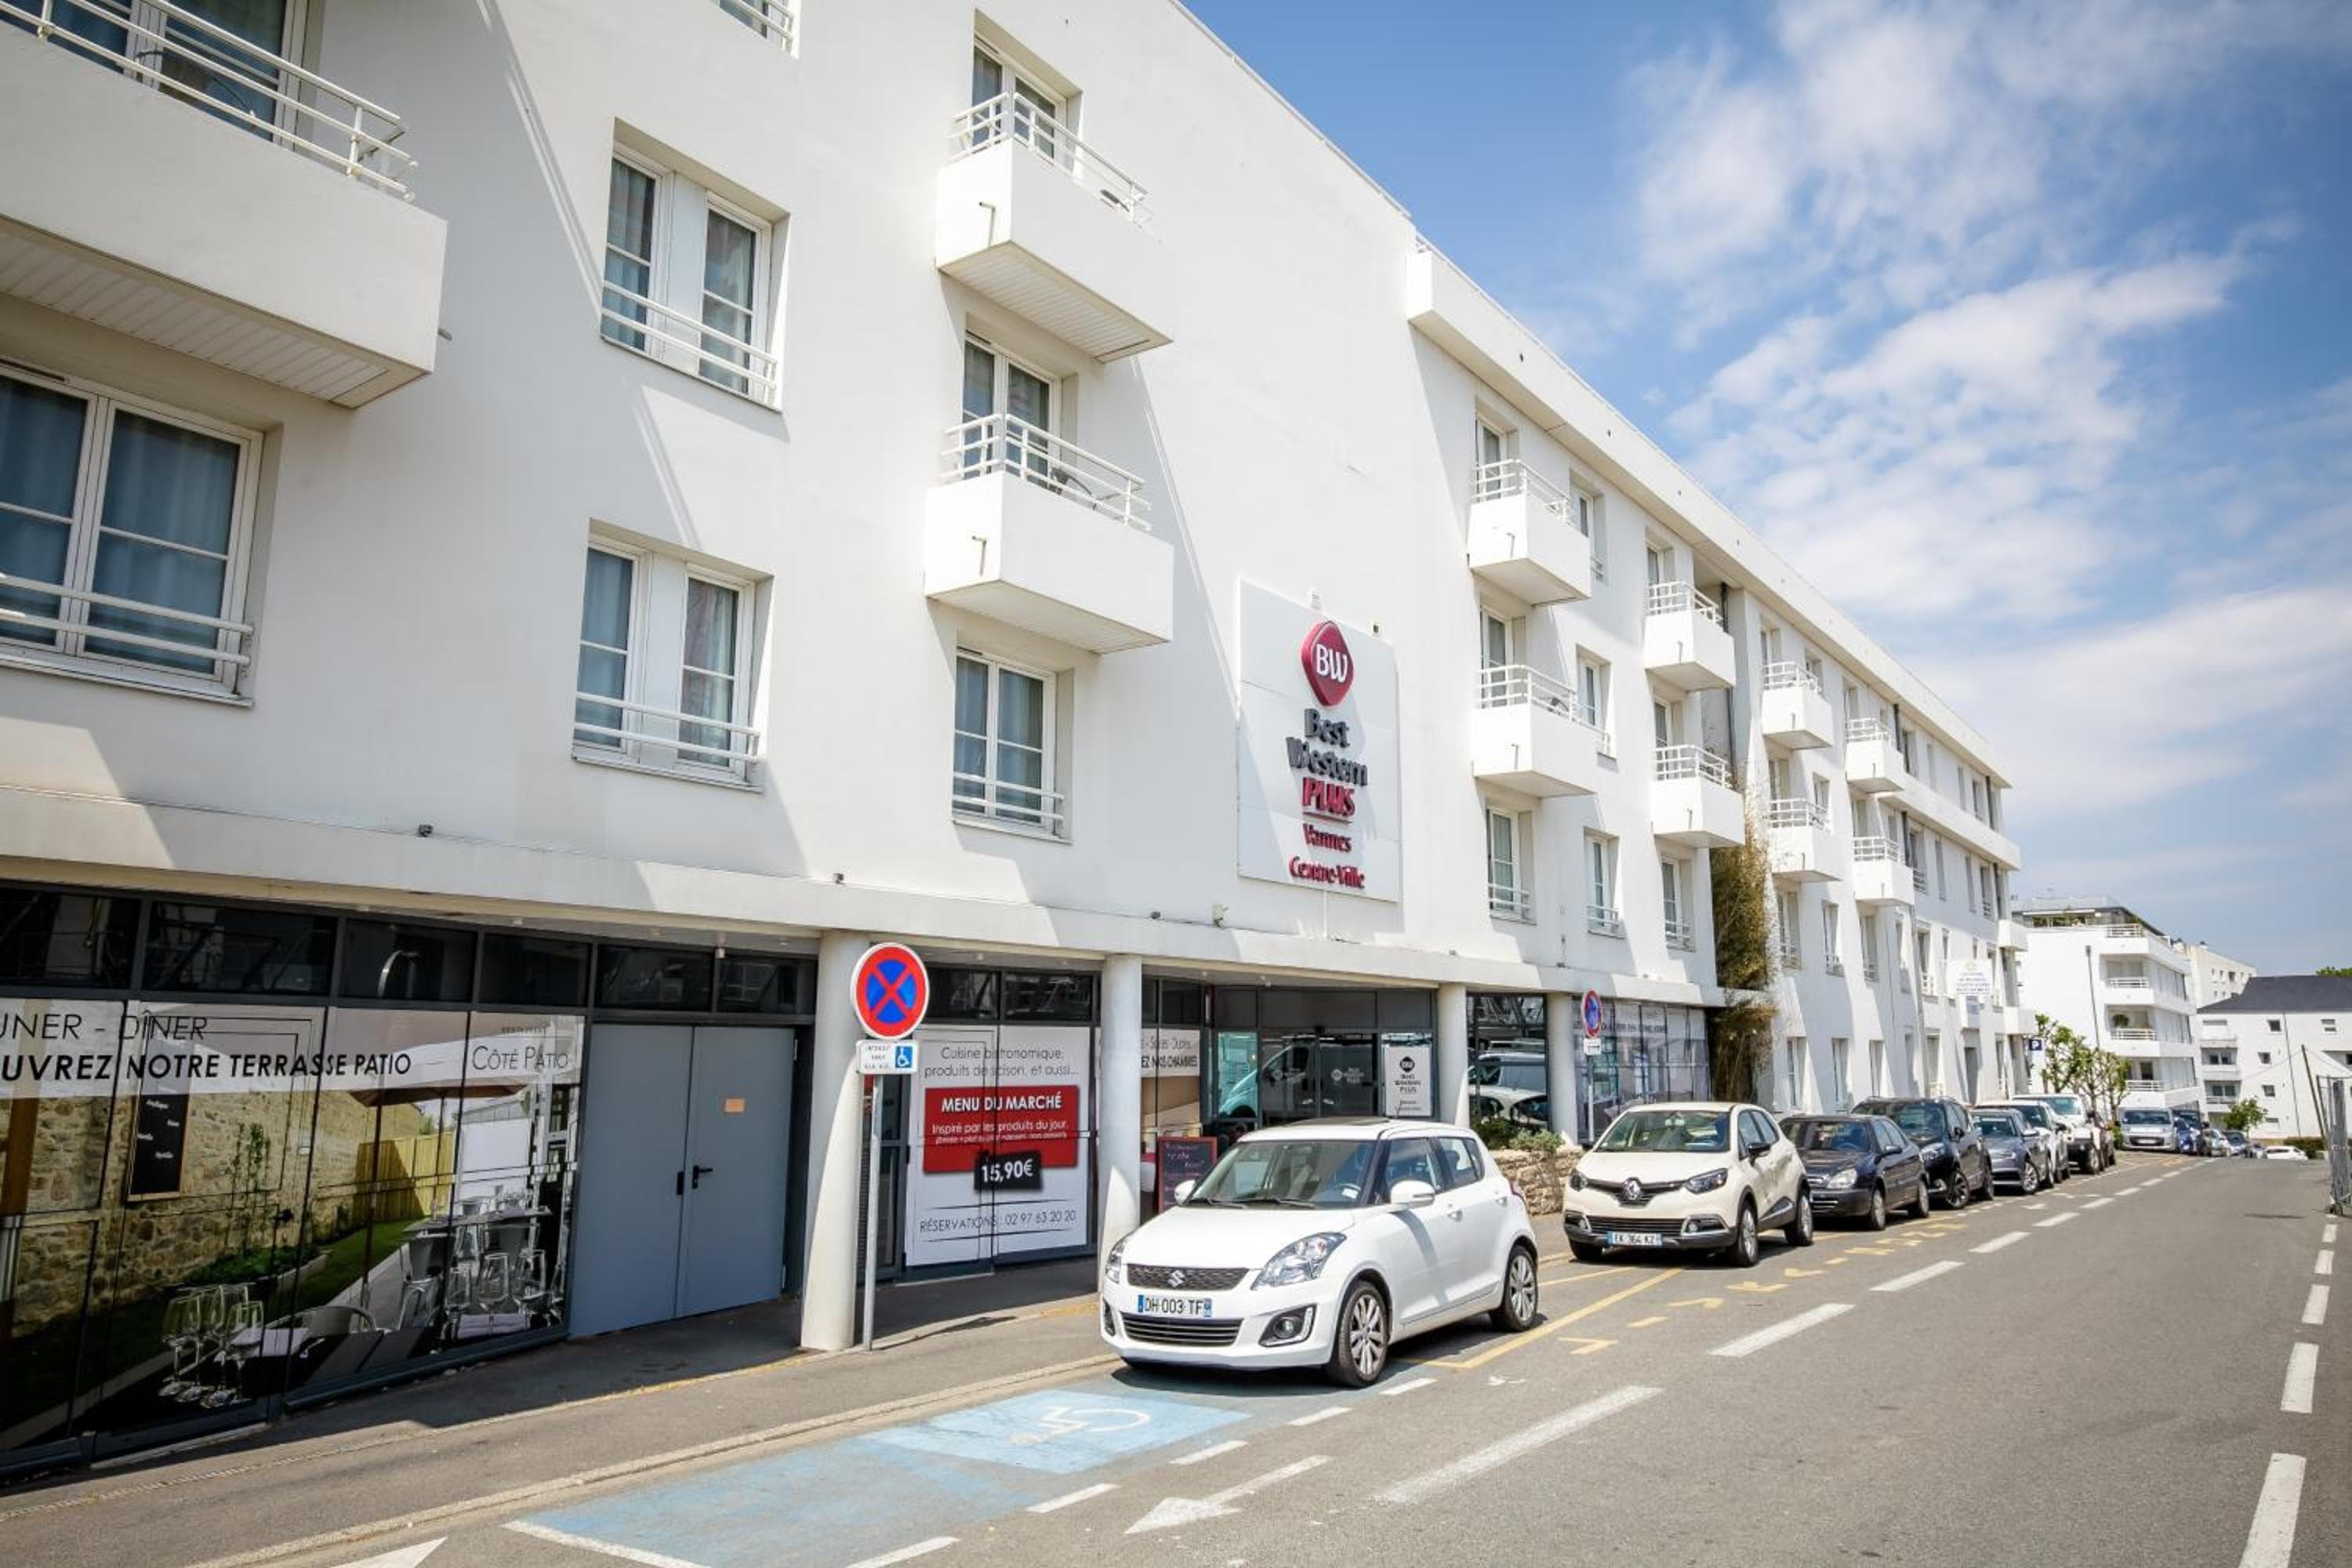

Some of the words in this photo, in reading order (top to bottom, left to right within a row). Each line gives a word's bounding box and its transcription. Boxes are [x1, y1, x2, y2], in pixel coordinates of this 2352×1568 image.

[1316, 644, 1348, 683] BW
[1305, 708, 1350, 748] Best
[1286, 737, 1368, 786] Western
[1302, 777, 1356, 816] PLUS
[1302, 823, 1352, 853] Vannes
[1289, 856, 1366, 889] Centre-Ville
[123, 1010, 208, 1040] DÎNER
[126, 1053, 220, 1079] NOTRE
[230, 1053, 347, 1077] TERRASSE
[354, 1053, 411, 1076] PATIO
[941, 1046, 981, 1060] Cuisine
[924, 1065, 970, 1079] produits
[973, 1065, 987, 1076] de
[1030, 1064, 1041, 1076] et
[941, 1097, 979, 1113] MENU
[984, 1096, 1003, 1112] DU
[1005, 1091, 1063, 1111] MARCHÉ
[964, 1123, 981, 1134] par
[998, 1120, 1034, 1134] produits
[1036, 1119, 1048, 1130] du
[982, 1158, 1034, 1182] 15,90€
[1020, 1212, 1033, 1224] 97
